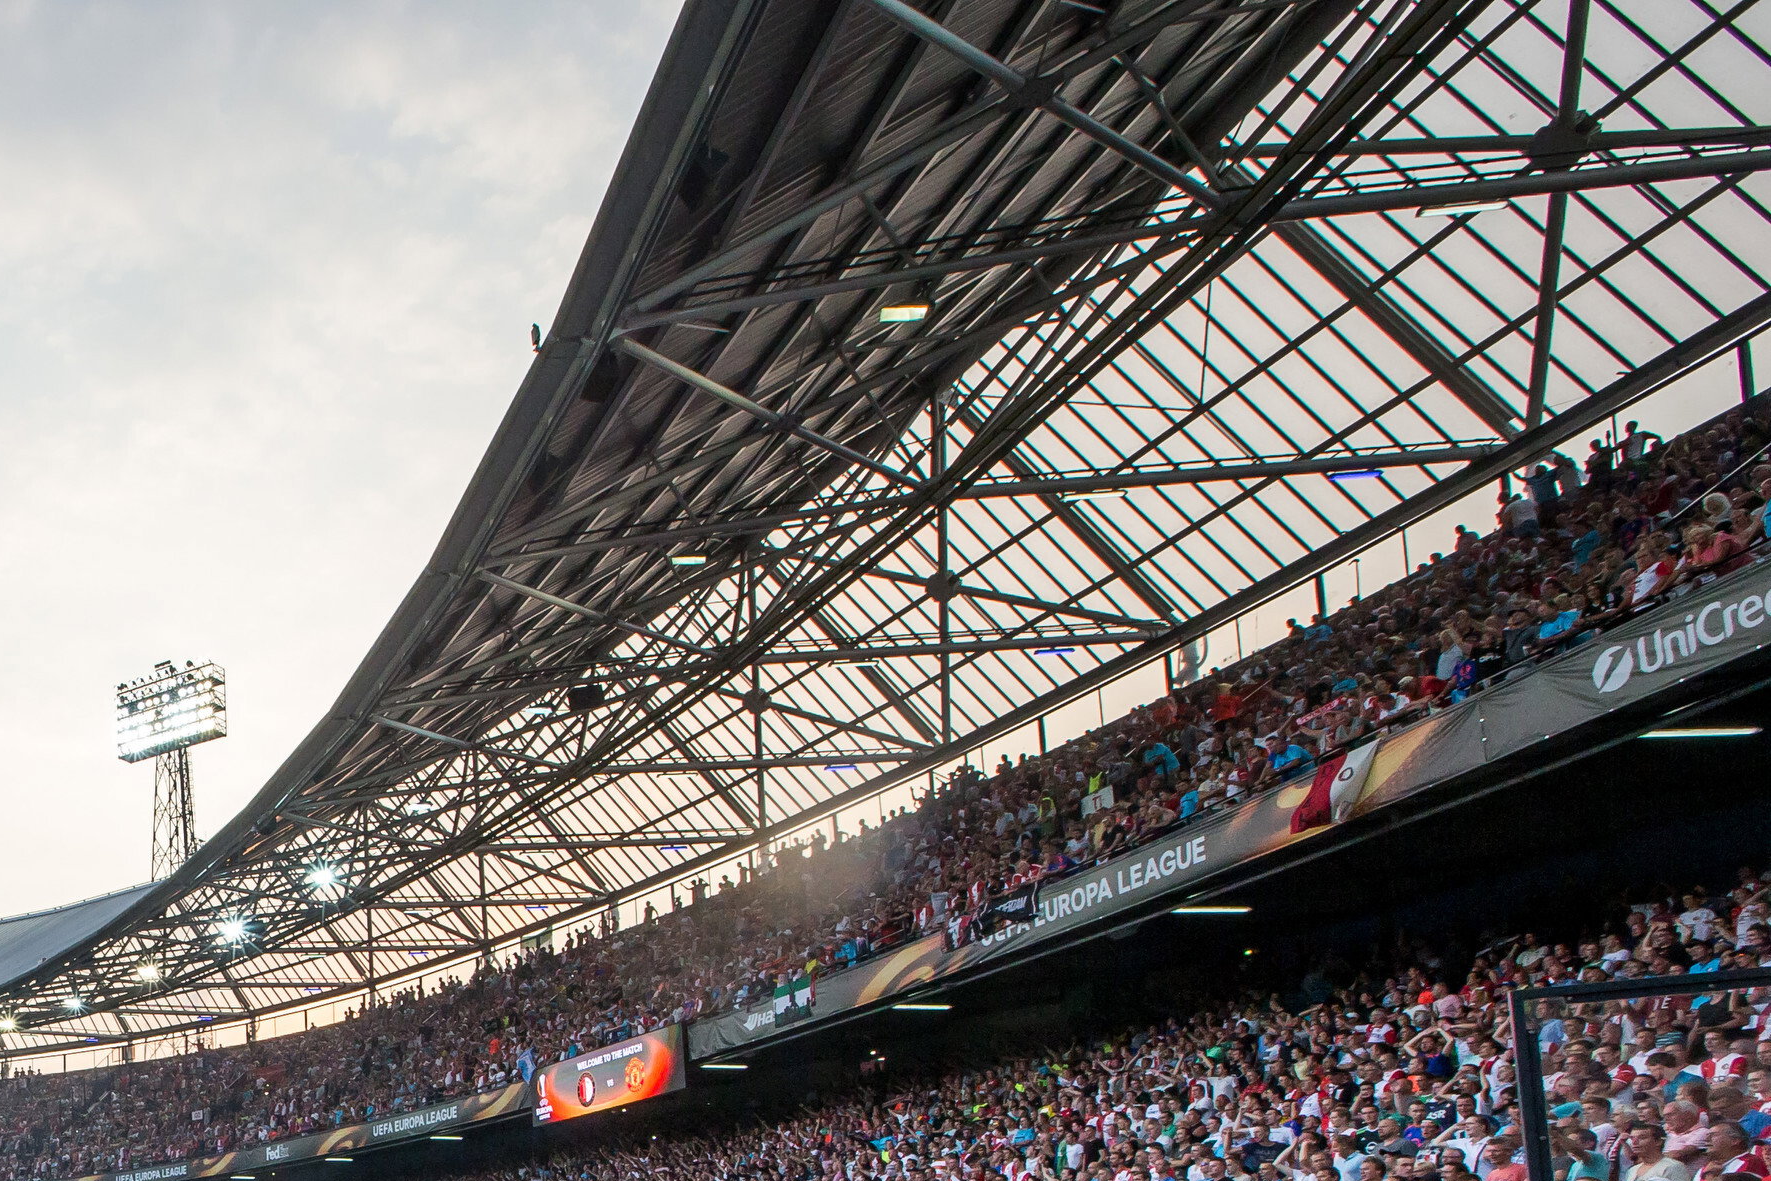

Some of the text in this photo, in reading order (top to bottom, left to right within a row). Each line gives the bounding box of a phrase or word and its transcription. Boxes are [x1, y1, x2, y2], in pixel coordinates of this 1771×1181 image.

[1636, 589, 1771, 674] UniCre
[1034, 877, 1113, 928] EUROPA
[1117, 835, 1207, 894] LEAGUE
[577, 1043, 643, 1071] WELCOME TO THE MATCH
[373, 1106, 457, 1137] UEFA EUROPA LEAGUE
[135, 1169, 160, 1181] EUROPA
[162, 1165, 187, 1178] LEAGUE
